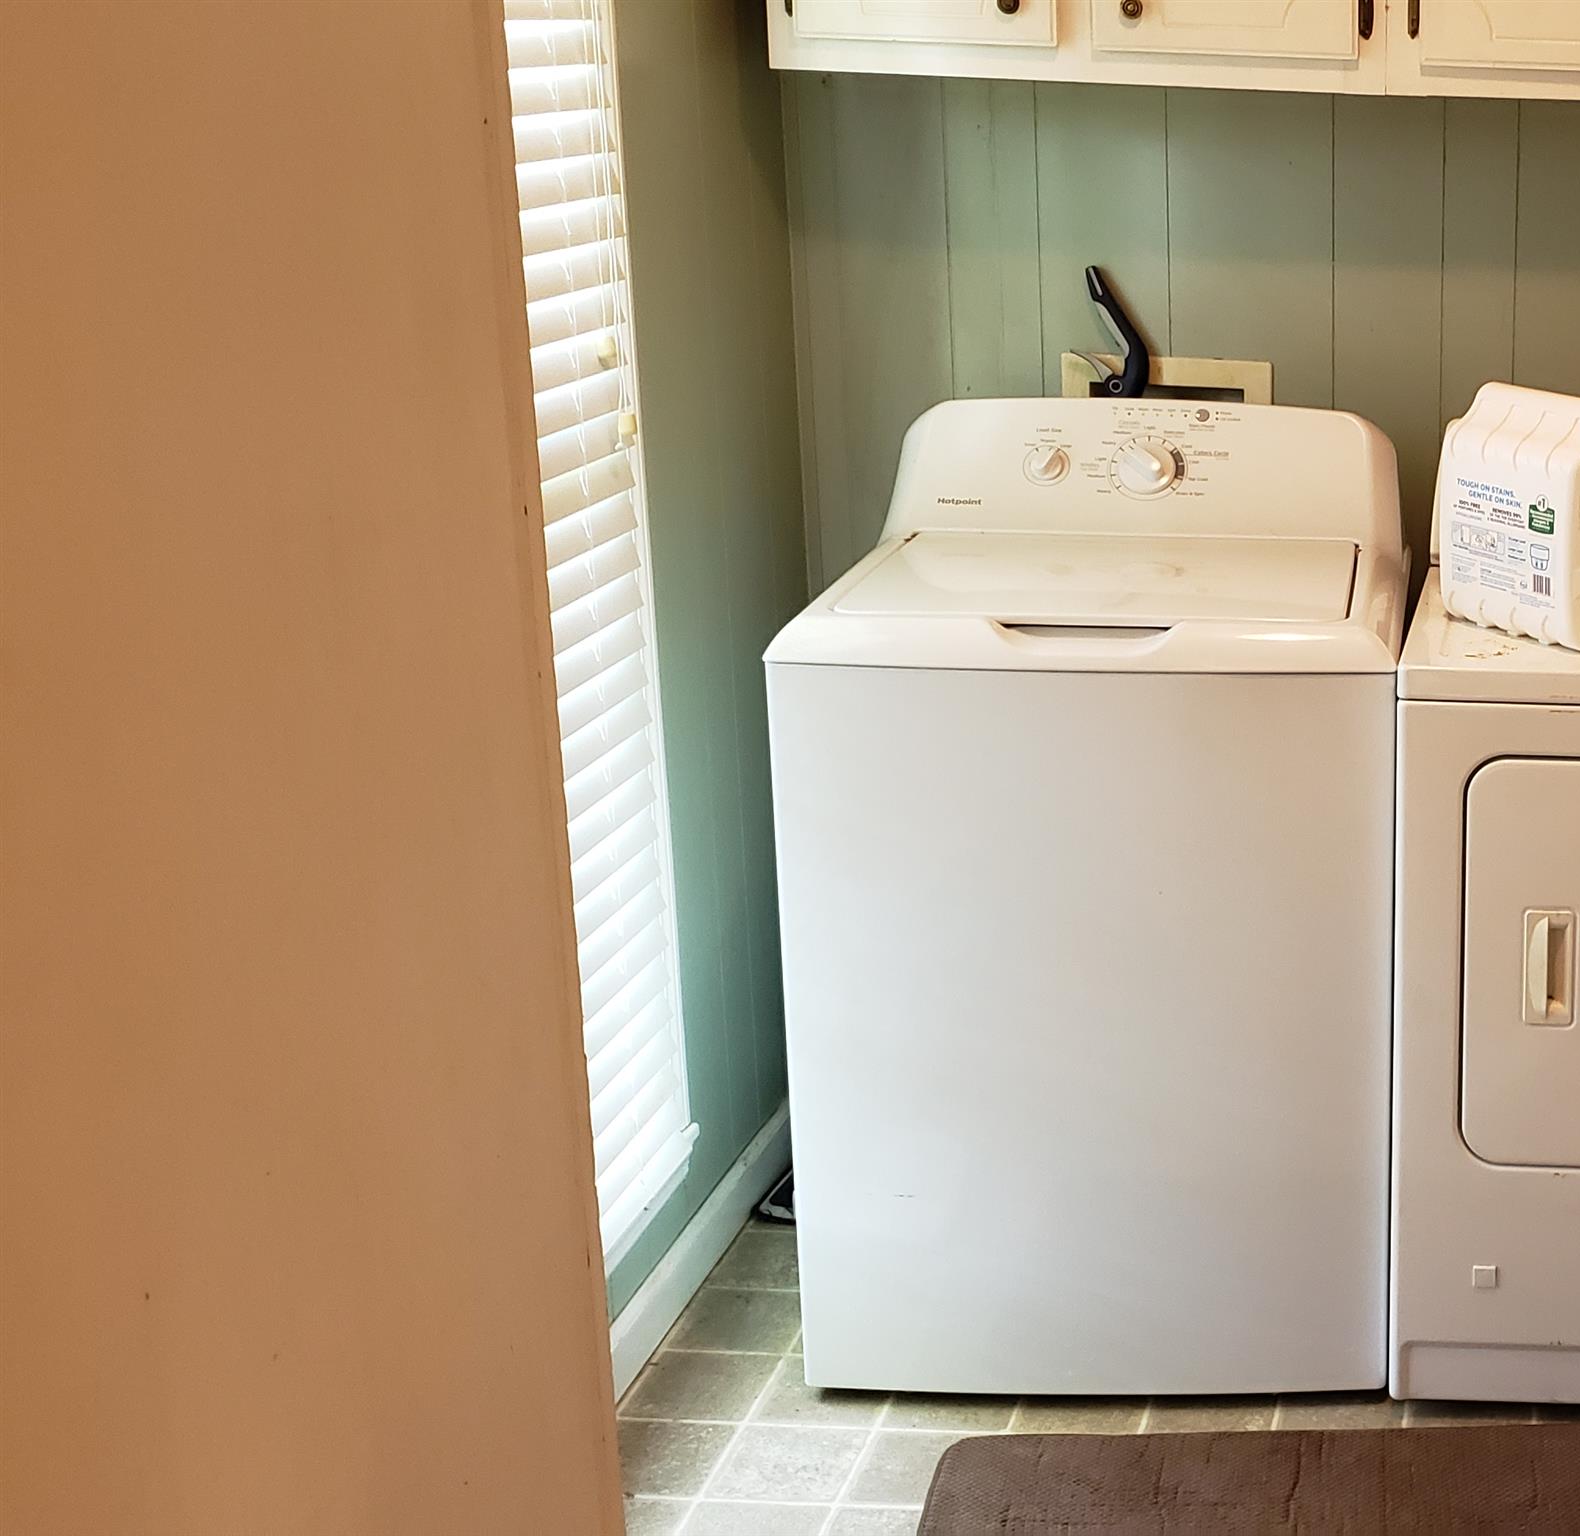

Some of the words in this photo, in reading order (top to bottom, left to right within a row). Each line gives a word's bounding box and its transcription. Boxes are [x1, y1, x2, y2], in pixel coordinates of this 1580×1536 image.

[1457, 478, 1479, 489] TOUGH
[1480, 483, 1490, 492] ON
[1491, 486, 1515, 498] STAINS.
[937, 497, 982, 506] Hotpoint
[1468, 490, 1493, 502] GENTLE
[1494, 495, 1504, 504] ON
